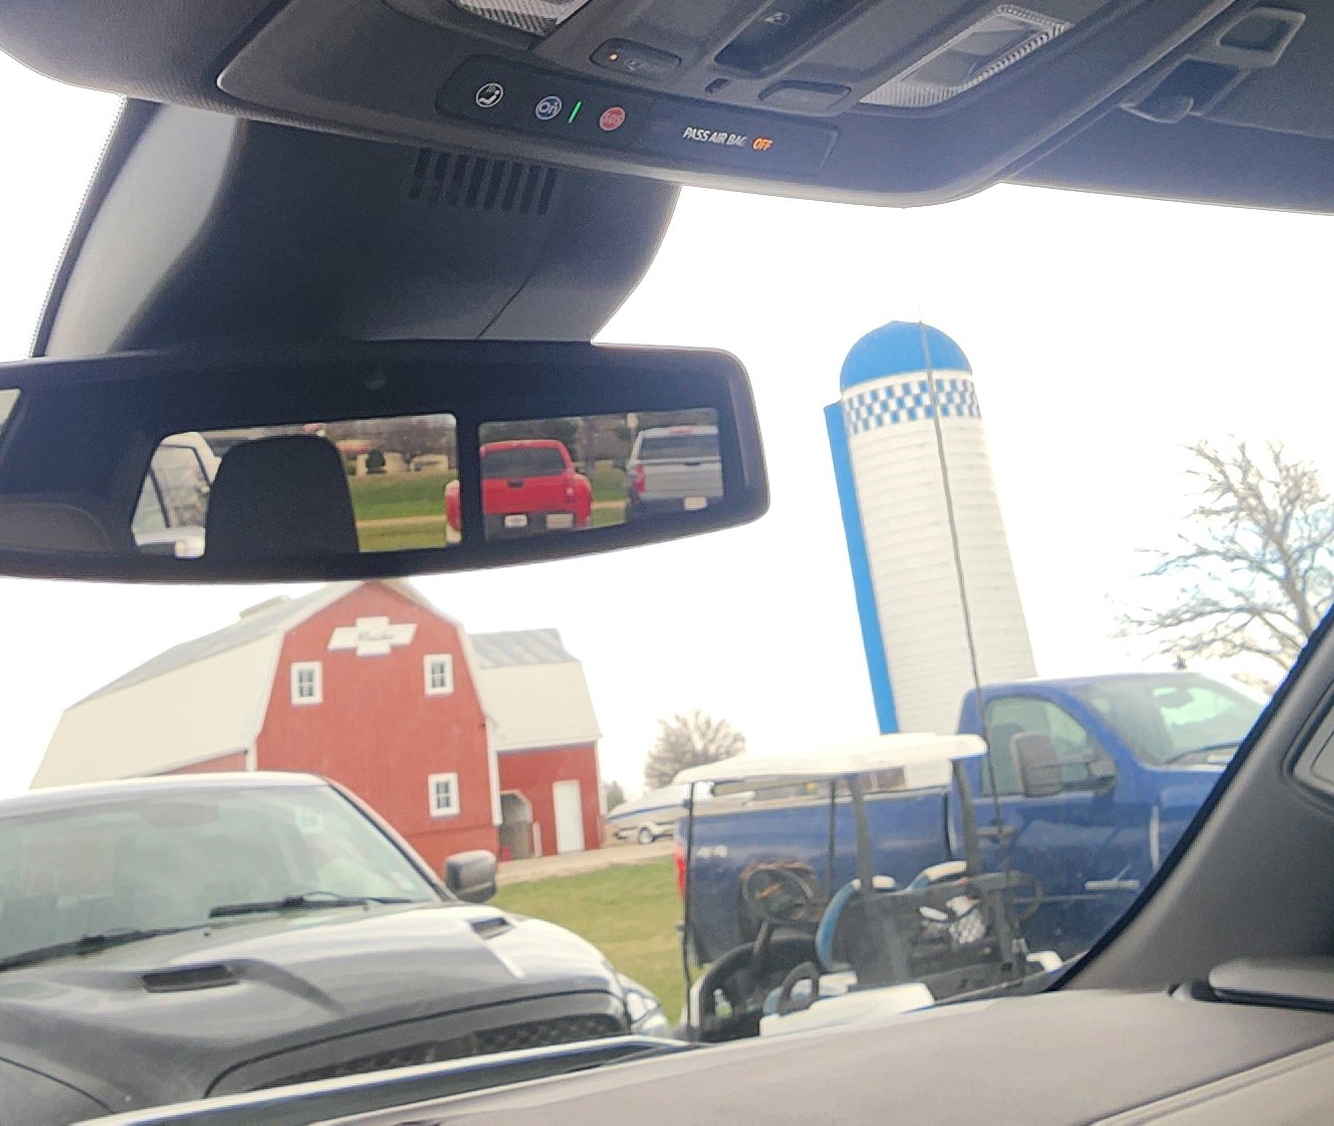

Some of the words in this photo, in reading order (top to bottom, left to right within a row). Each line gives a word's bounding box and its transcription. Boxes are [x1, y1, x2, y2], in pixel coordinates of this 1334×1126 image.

[682, 127, 711, 142] PASS
[708, 132, 728, 145] AIR
[753, 138, 773, 150] OFF
